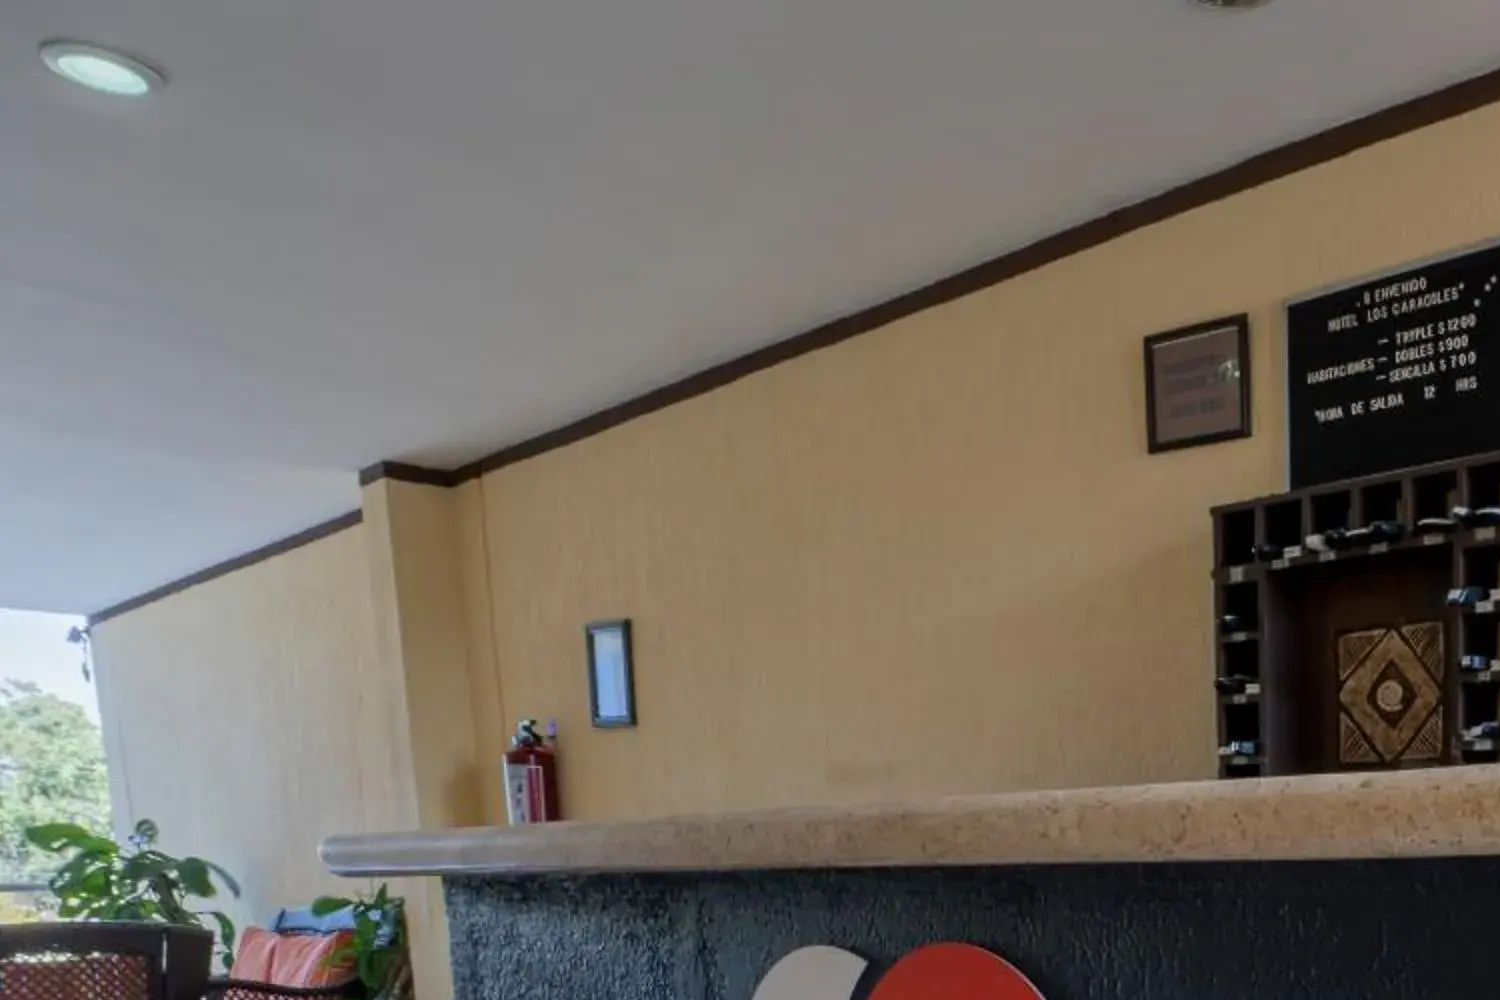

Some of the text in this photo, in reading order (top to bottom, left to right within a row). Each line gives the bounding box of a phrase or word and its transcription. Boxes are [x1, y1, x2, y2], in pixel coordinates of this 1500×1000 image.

[1327, 314, 1358, 332] HOTEL
[1367, 307, 1388, 322] LOS
[1395, 323, 1434, 345] TRIPLE
[1395, 343, 1434, 363] DOBLES
[1351, 400, 1365, 416] DE
[1370, 393, 1404, 412] SALIDA
[1423, 385, 1436, 400] 12
